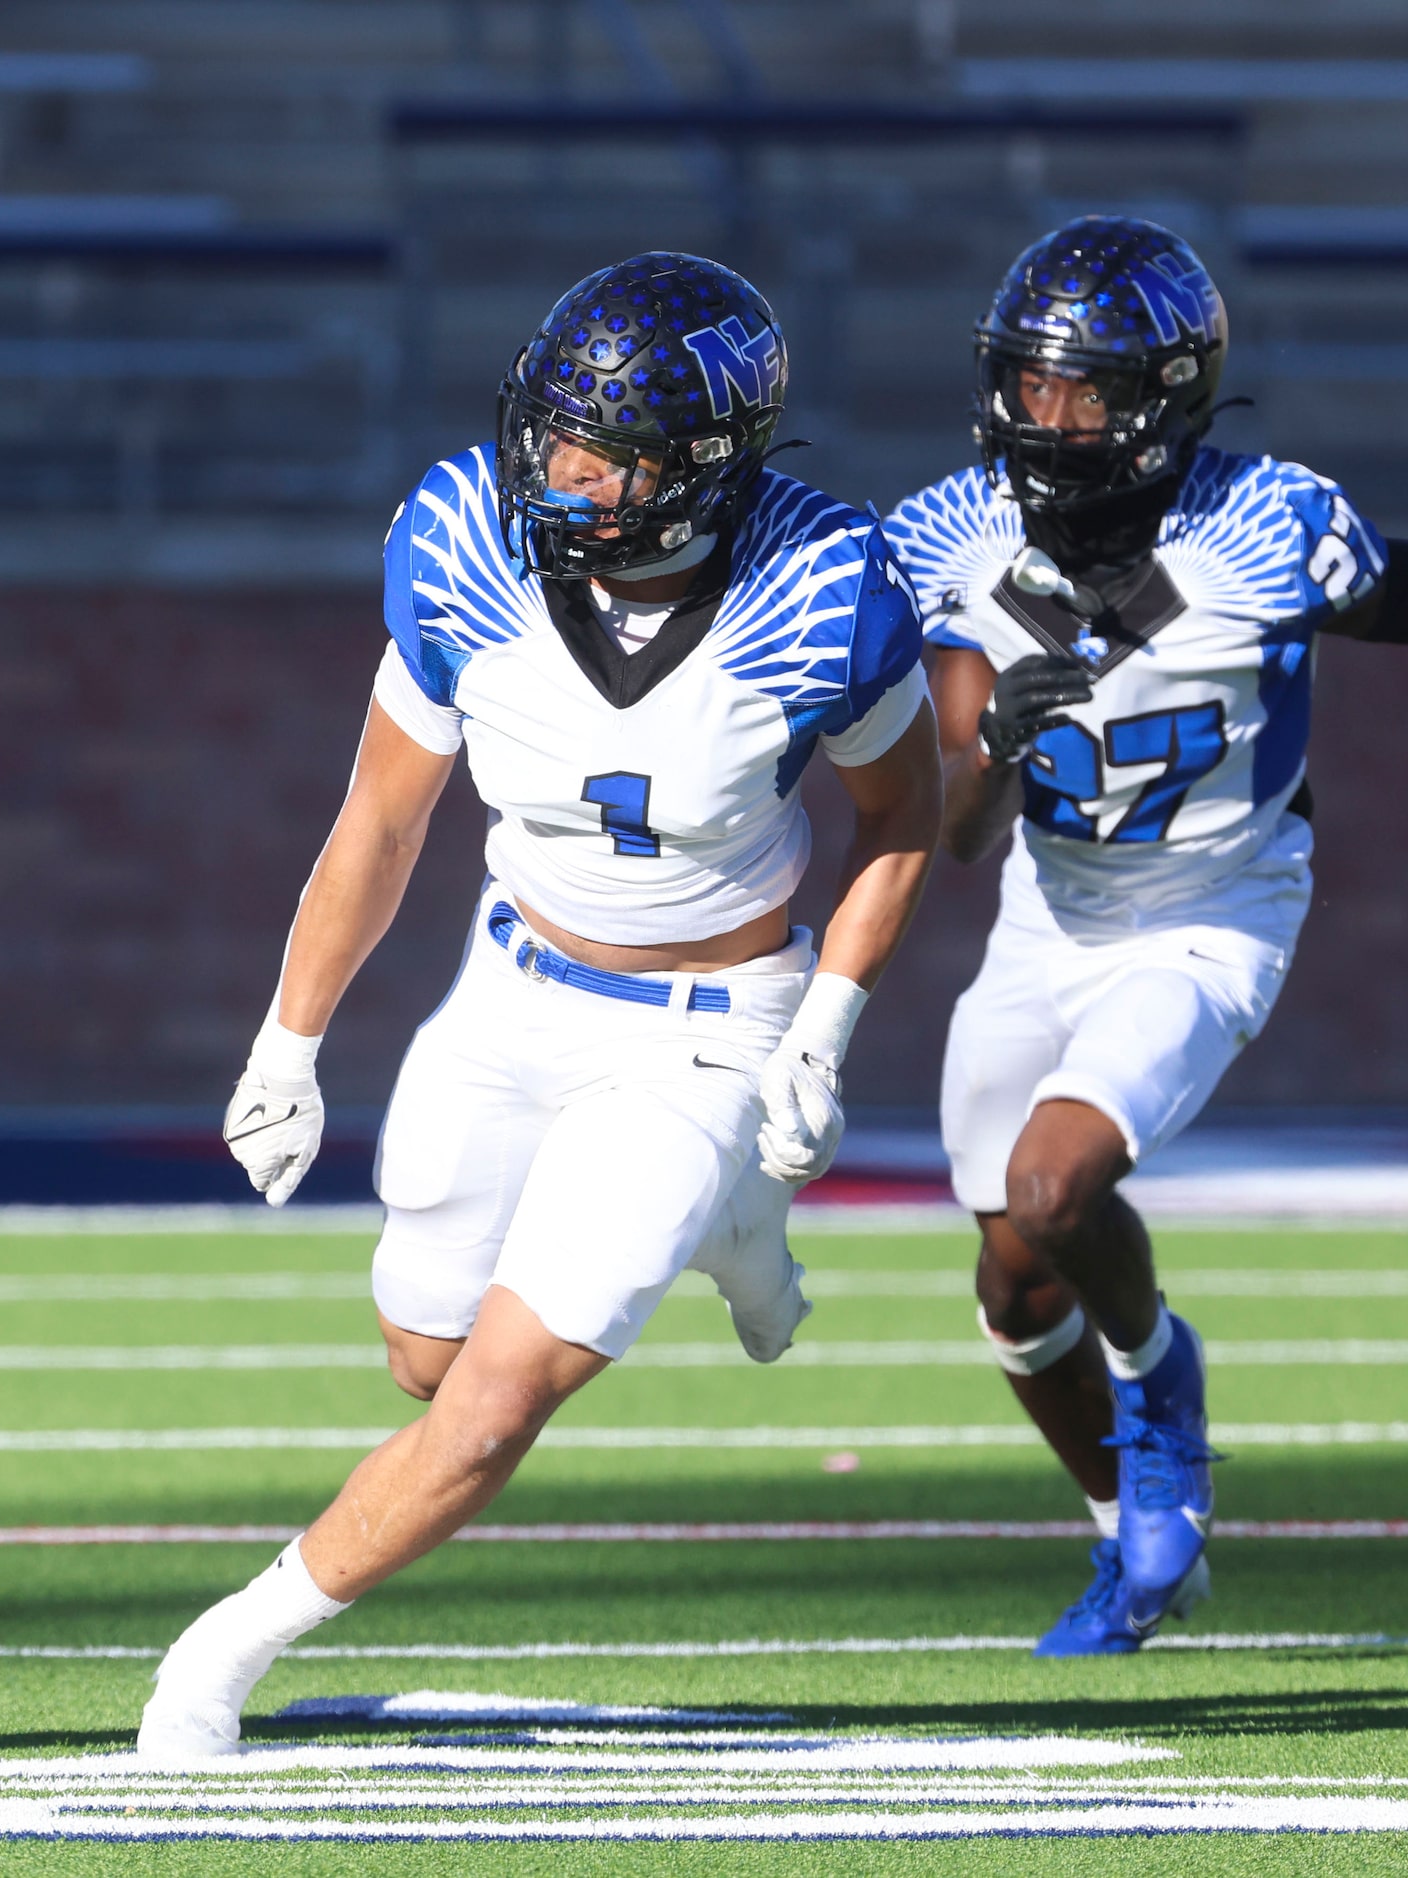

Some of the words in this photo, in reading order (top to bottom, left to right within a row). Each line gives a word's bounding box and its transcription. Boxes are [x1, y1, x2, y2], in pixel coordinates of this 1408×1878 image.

[682, 315, 780, 420] NF
[579, 770, 661, 857] 1
[1022, 699, 1229, 843] 27
